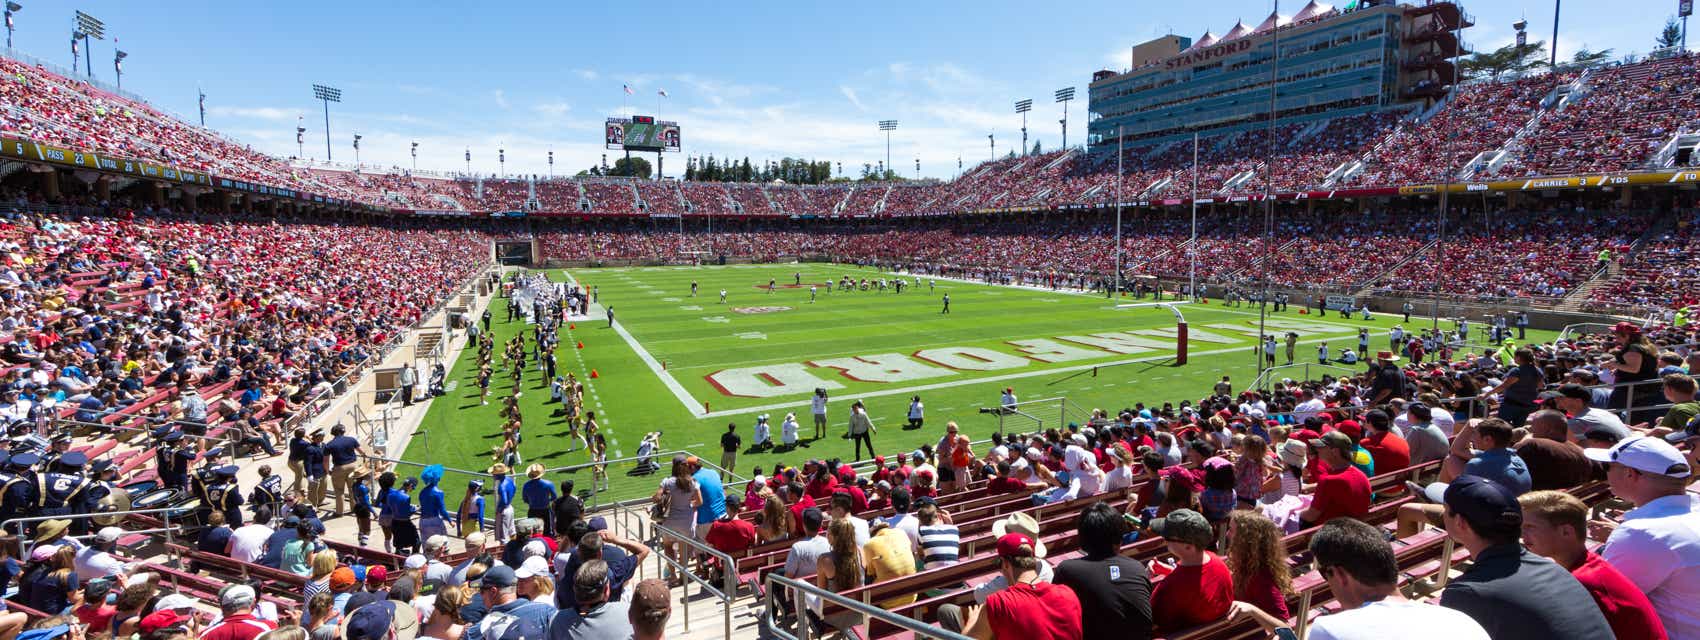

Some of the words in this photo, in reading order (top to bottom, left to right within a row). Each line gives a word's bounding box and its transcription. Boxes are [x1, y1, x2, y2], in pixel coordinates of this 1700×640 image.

[1165, 39, 1251, 70] STANFORD
[16, 143, 23, 155] 5
[47, 149, 65, 160] PASS
[74, 153, 84, 165] 23
[1610, 176, 1629, 184] YDS
[1684, 173, 1697, 181] TD
[1466, 183, 1489, 191] Wells
[1533, 180, 1569, 188] CARRIES
[1580, 178, 1586, 186] 3
